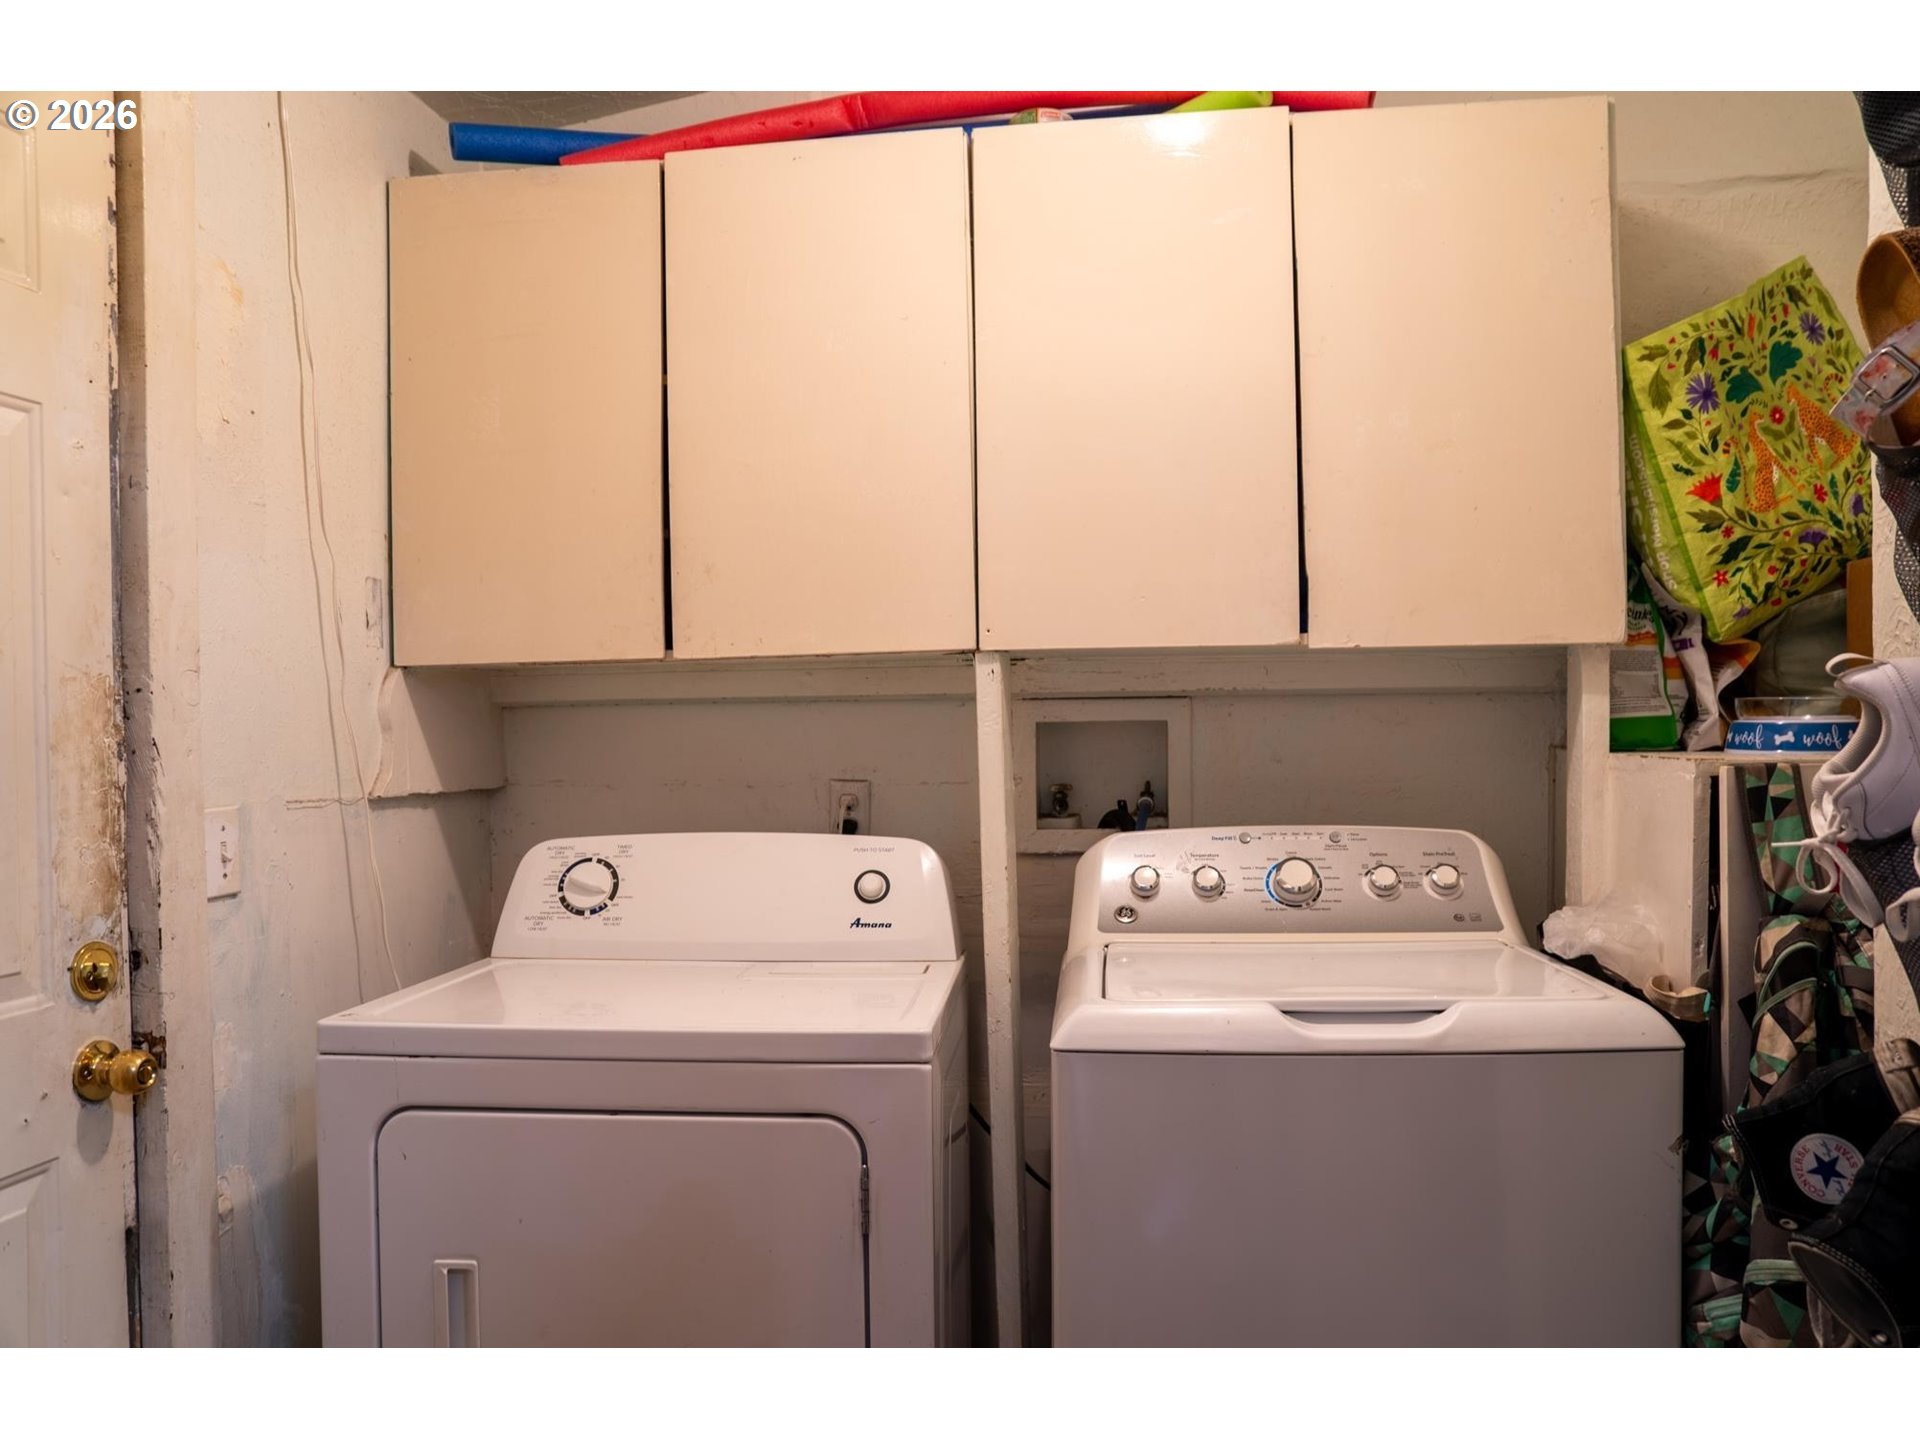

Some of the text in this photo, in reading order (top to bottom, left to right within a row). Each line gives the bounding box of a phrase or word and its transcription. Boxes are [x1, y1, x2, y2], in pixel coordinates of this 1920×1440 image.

[1628, 432, 1663, 548] Marshalls.com
[1656, 551, 1678, 590] Shop
[1734, 724, 1842, 749] woof woof
[850, 917, 892, 929] Amana
[1794, 1144, 1826, 1198] CONVERSE
[1834, 1143, 1859, 1169] STAR
